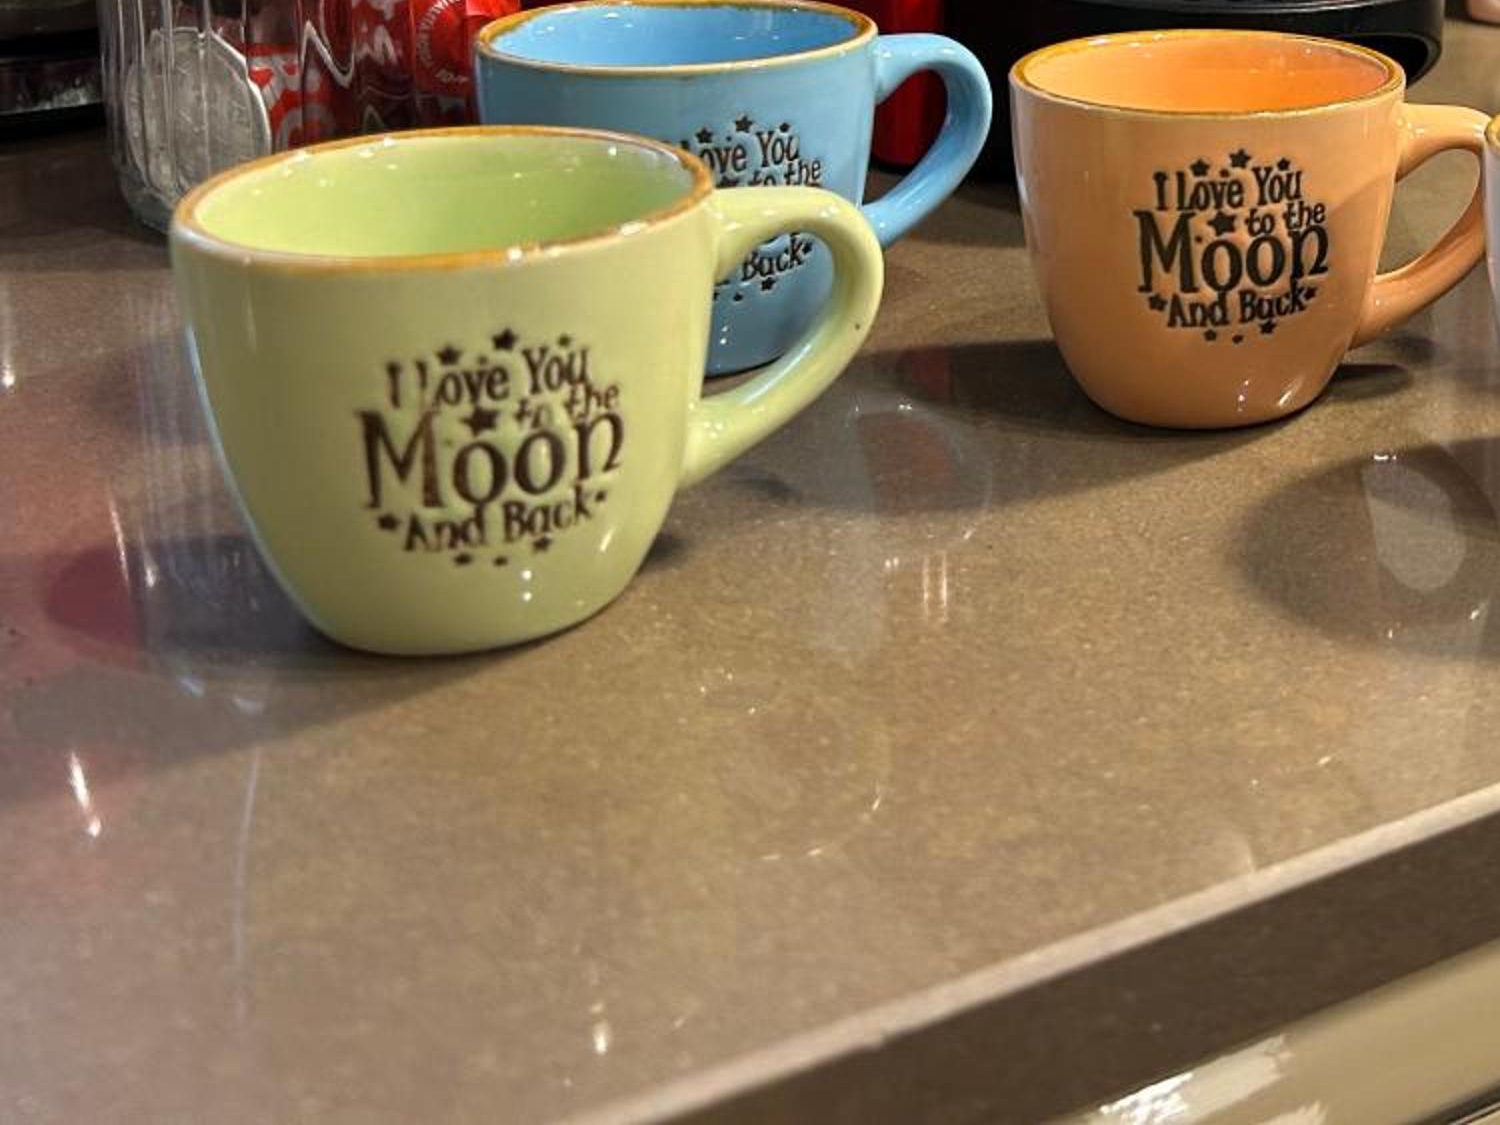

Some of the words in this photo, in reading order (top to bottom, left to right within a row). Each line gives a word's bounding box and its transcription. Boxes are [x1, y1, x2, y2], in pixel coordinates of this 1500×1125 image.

[690, 141, 747, 173] ove
[756, 131, 800, 167] You
[784, 158, 822, 186] the
[1153, 171, 1168, 211] I
[1175, 170, 1245, 212] Love
[1251, 166, 1303, 206] You
[1244, 208, 1276, 235] to
[1282, 200, 1326, 229] the
[1132, 210, 1329, 293] Moon
[1167, 290, 1230, 328] And
[1238, 280, 1307, 324] Back
[385, 360, 402, 409] I
[415, 358, 510, 416] Love
[521, 346, 590, 396] You
[562, 379, 620, 420] the
[354, 408, 625, 509] Moon
[402, 504, 488, 553] And
[502, 483, 593, 543] Back
